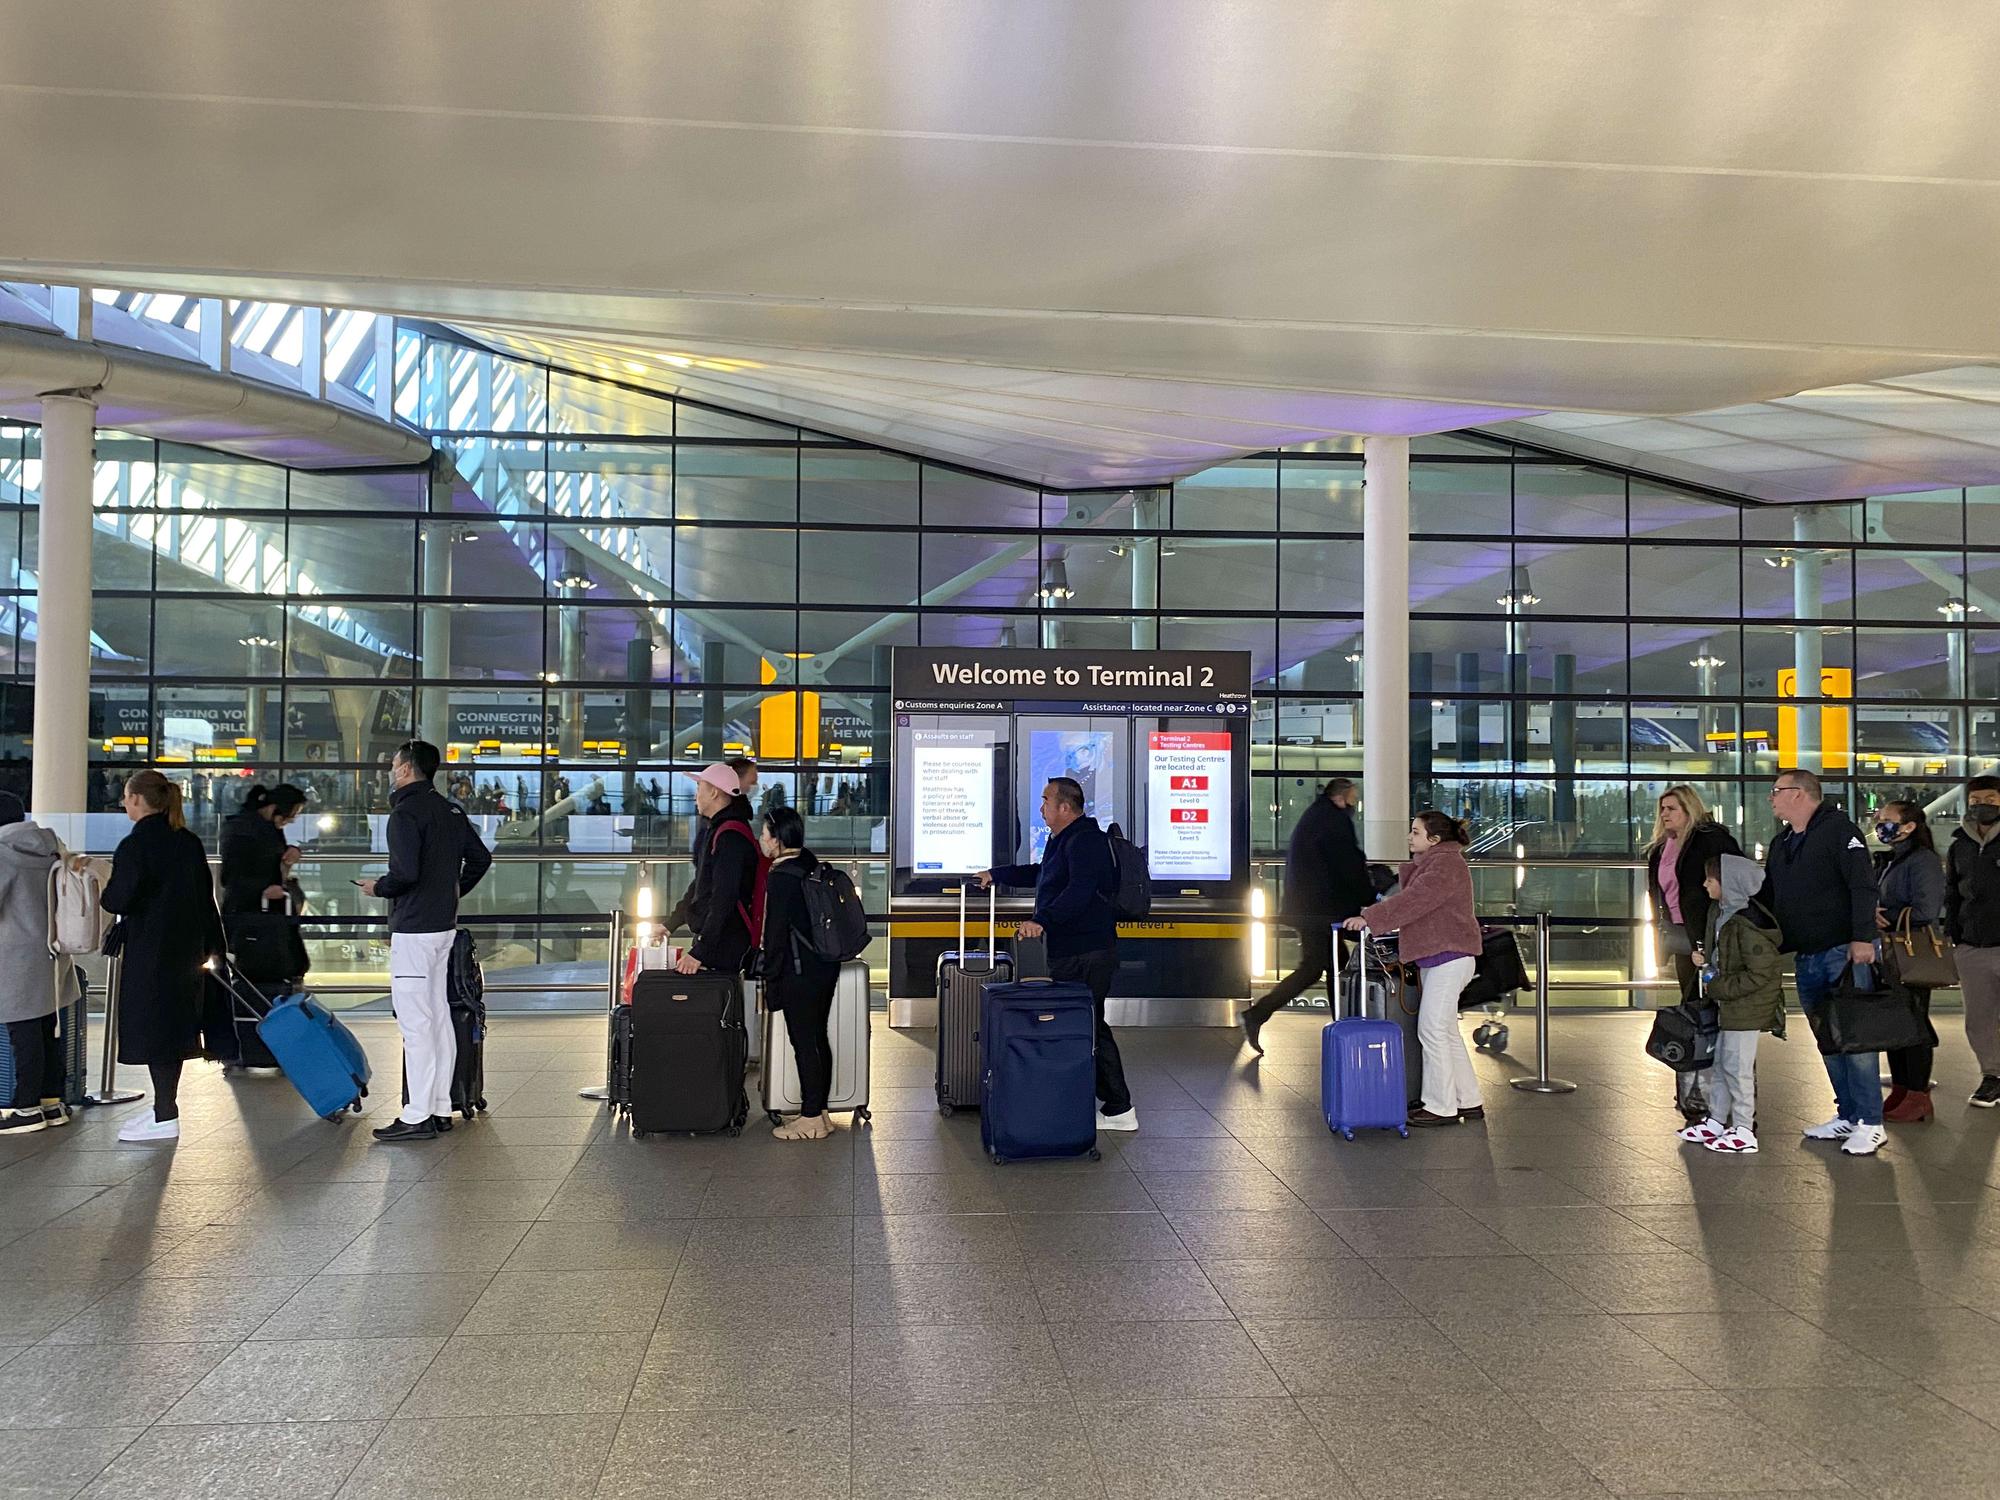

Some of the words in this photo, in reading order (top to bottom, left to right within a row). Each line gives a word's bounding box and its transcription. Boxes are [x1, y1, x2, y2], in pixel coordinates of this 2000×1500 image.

[932, 663, 1047, 685] Welcome
[1054, 667, 1080, 686] to
[1087, 665, 1192, 687] Terminal
[1200, 667, 1214, 687] 2
[939, 702, 975, 711] enquiries
[1132, 704, 1160, 712] located
[459, 725, 495, 735] WITH
[498, 725, 527, 735] THE
[1170, 755, 1196, 763] Testing
[1182, 778, 1198, 788] A1
[1182, 811, 1198, 821] D2
